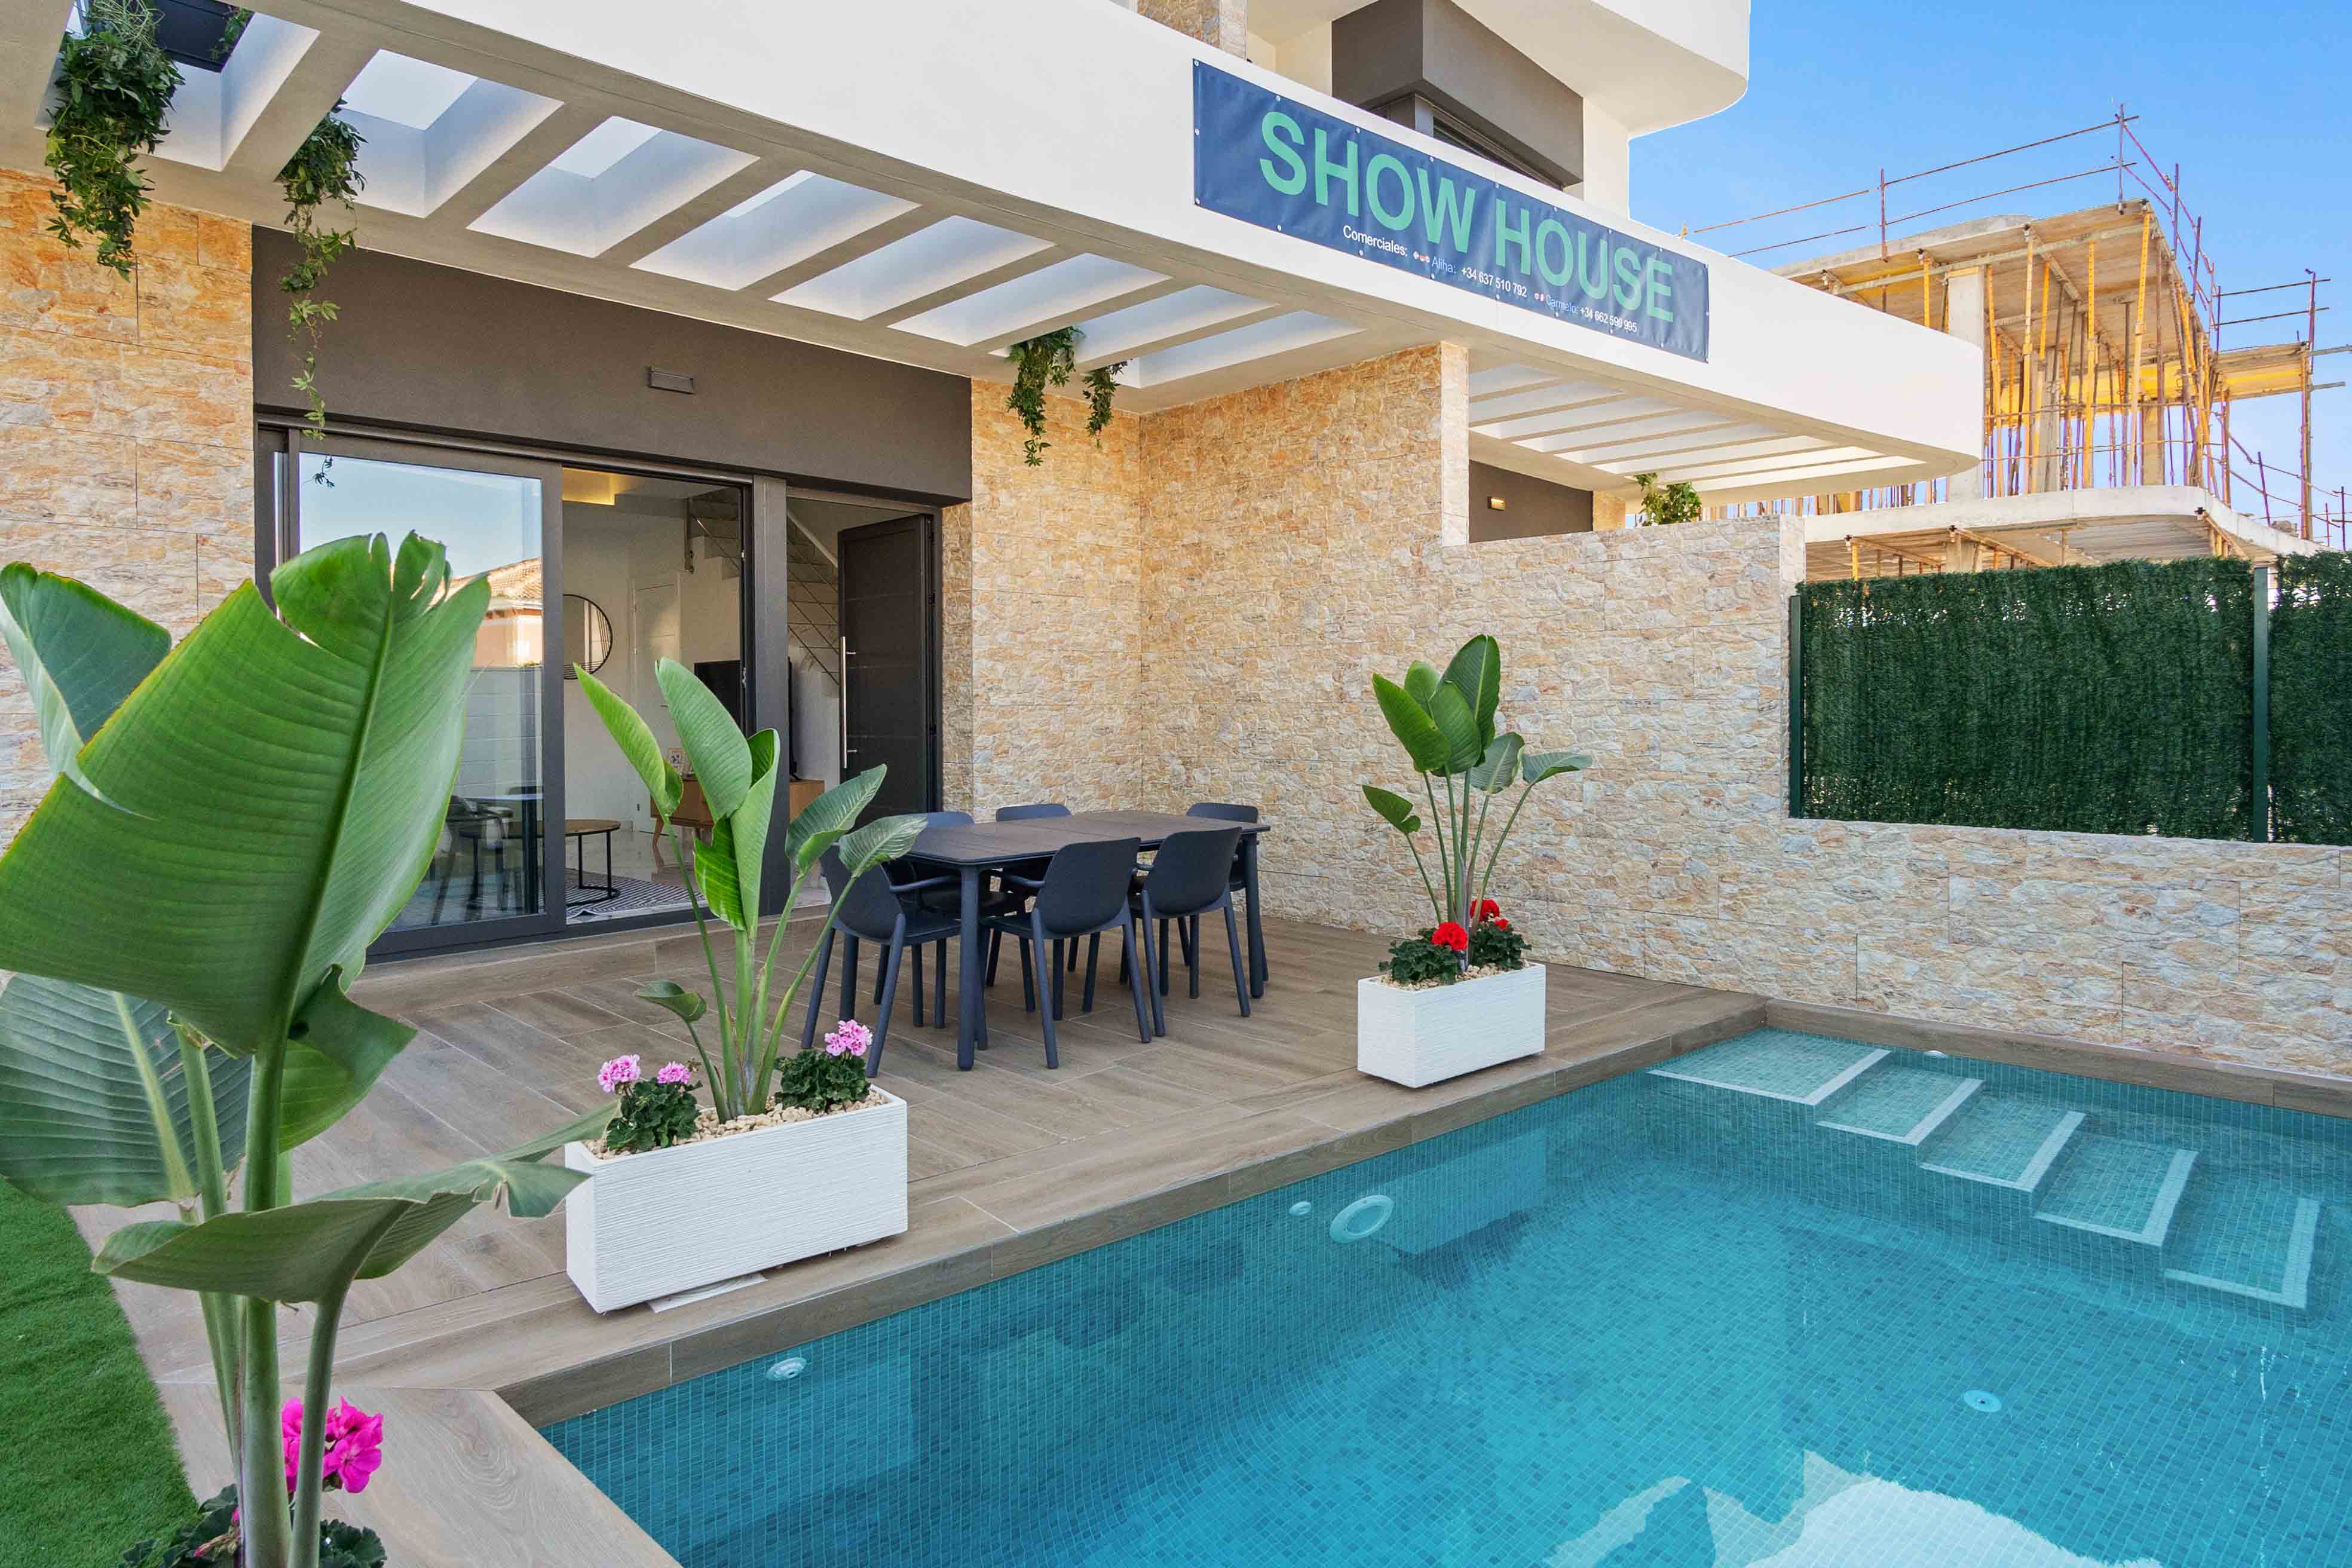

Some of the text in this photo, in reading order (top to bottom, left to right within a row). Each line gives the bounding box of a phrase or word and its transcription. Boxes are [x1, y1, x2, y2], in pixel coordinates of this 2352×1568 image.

[1260, 112, 1674, 321] SHOW HOUSE
[1343, 225, 1408, 257] Comerciales:
[1462, 267, 1478, 280] +34
[1479, 272, 1494, 286] 637
[1496, 277, 1511, 292] 510
[1513, 283, 1527, 298] 792
[1580, 307, 1593, 319] +34
[1595, 310, 1608, 324] 662
